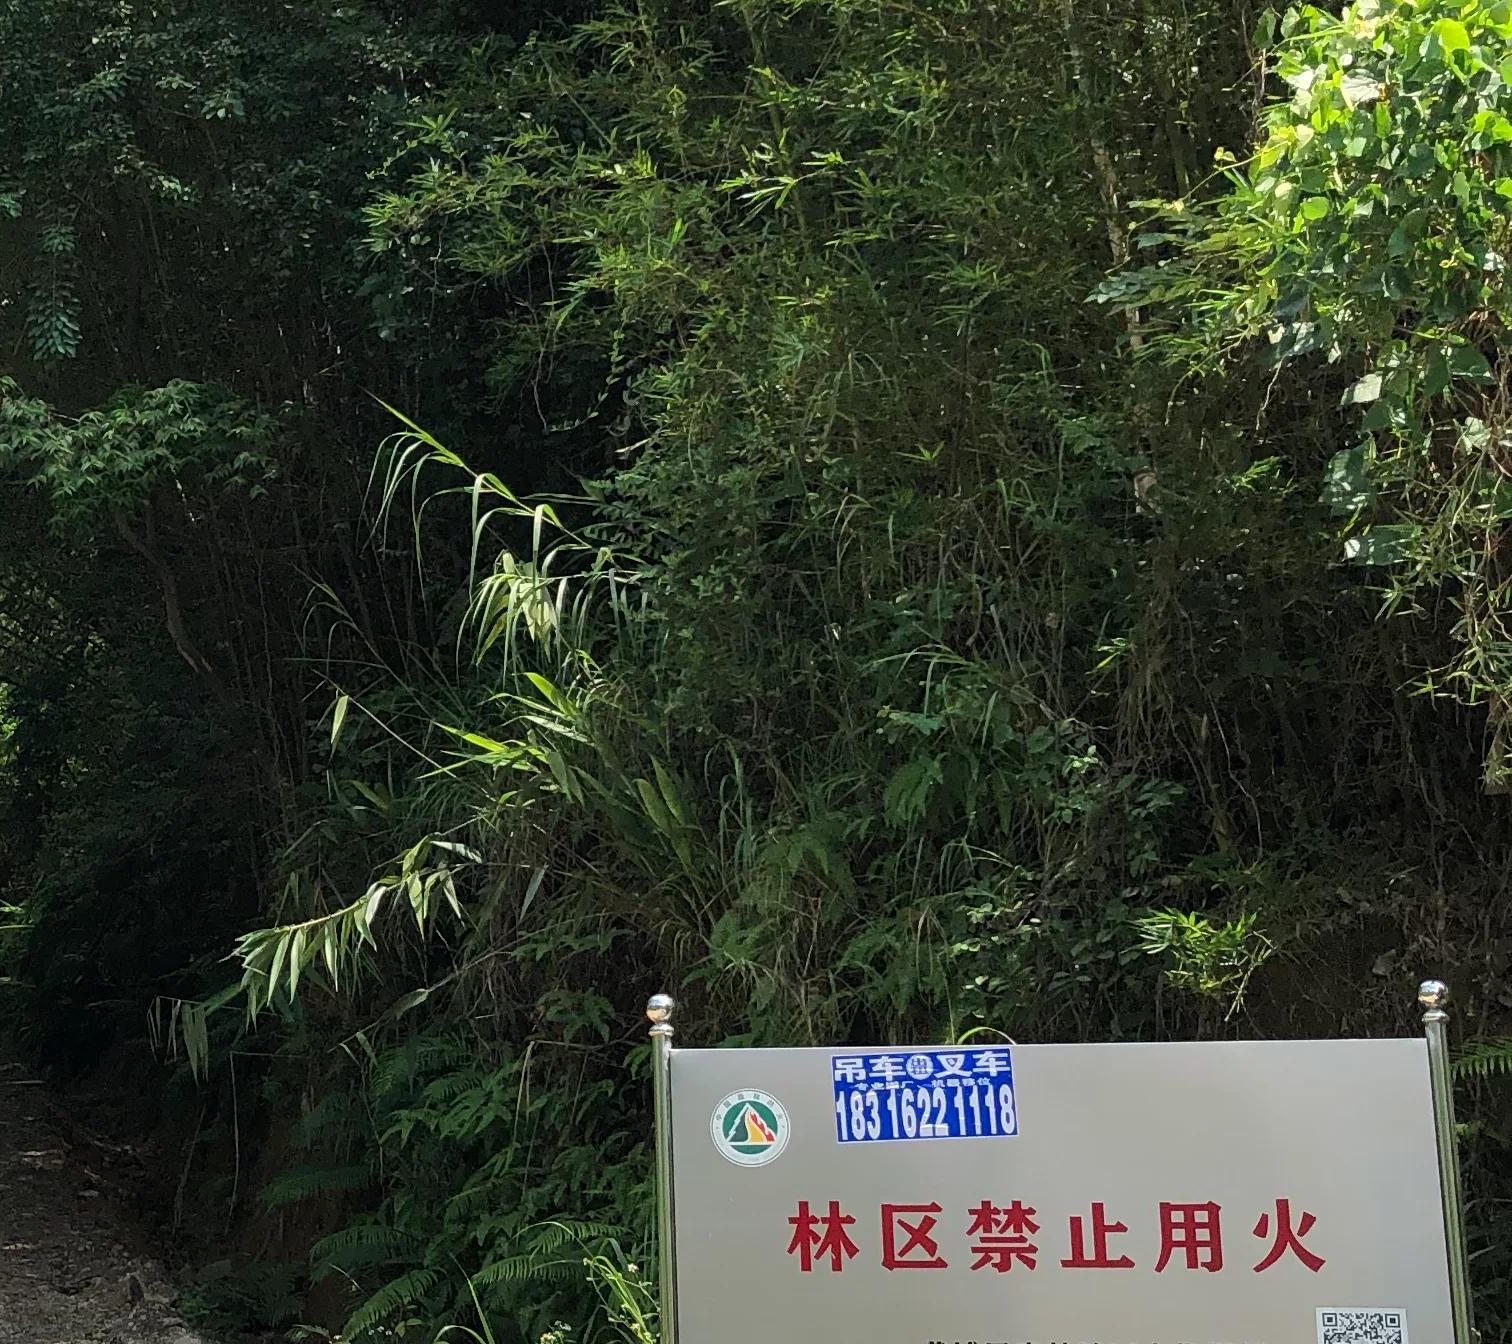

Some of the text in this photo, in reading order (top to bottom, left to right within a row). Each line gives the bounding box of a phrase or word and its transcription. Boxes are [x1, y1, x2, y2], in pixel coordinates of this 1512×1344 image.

[836, 1084, 1016, 1141] 18316221118
[786, 1197, 1327, 1274] 林区禁止用火
